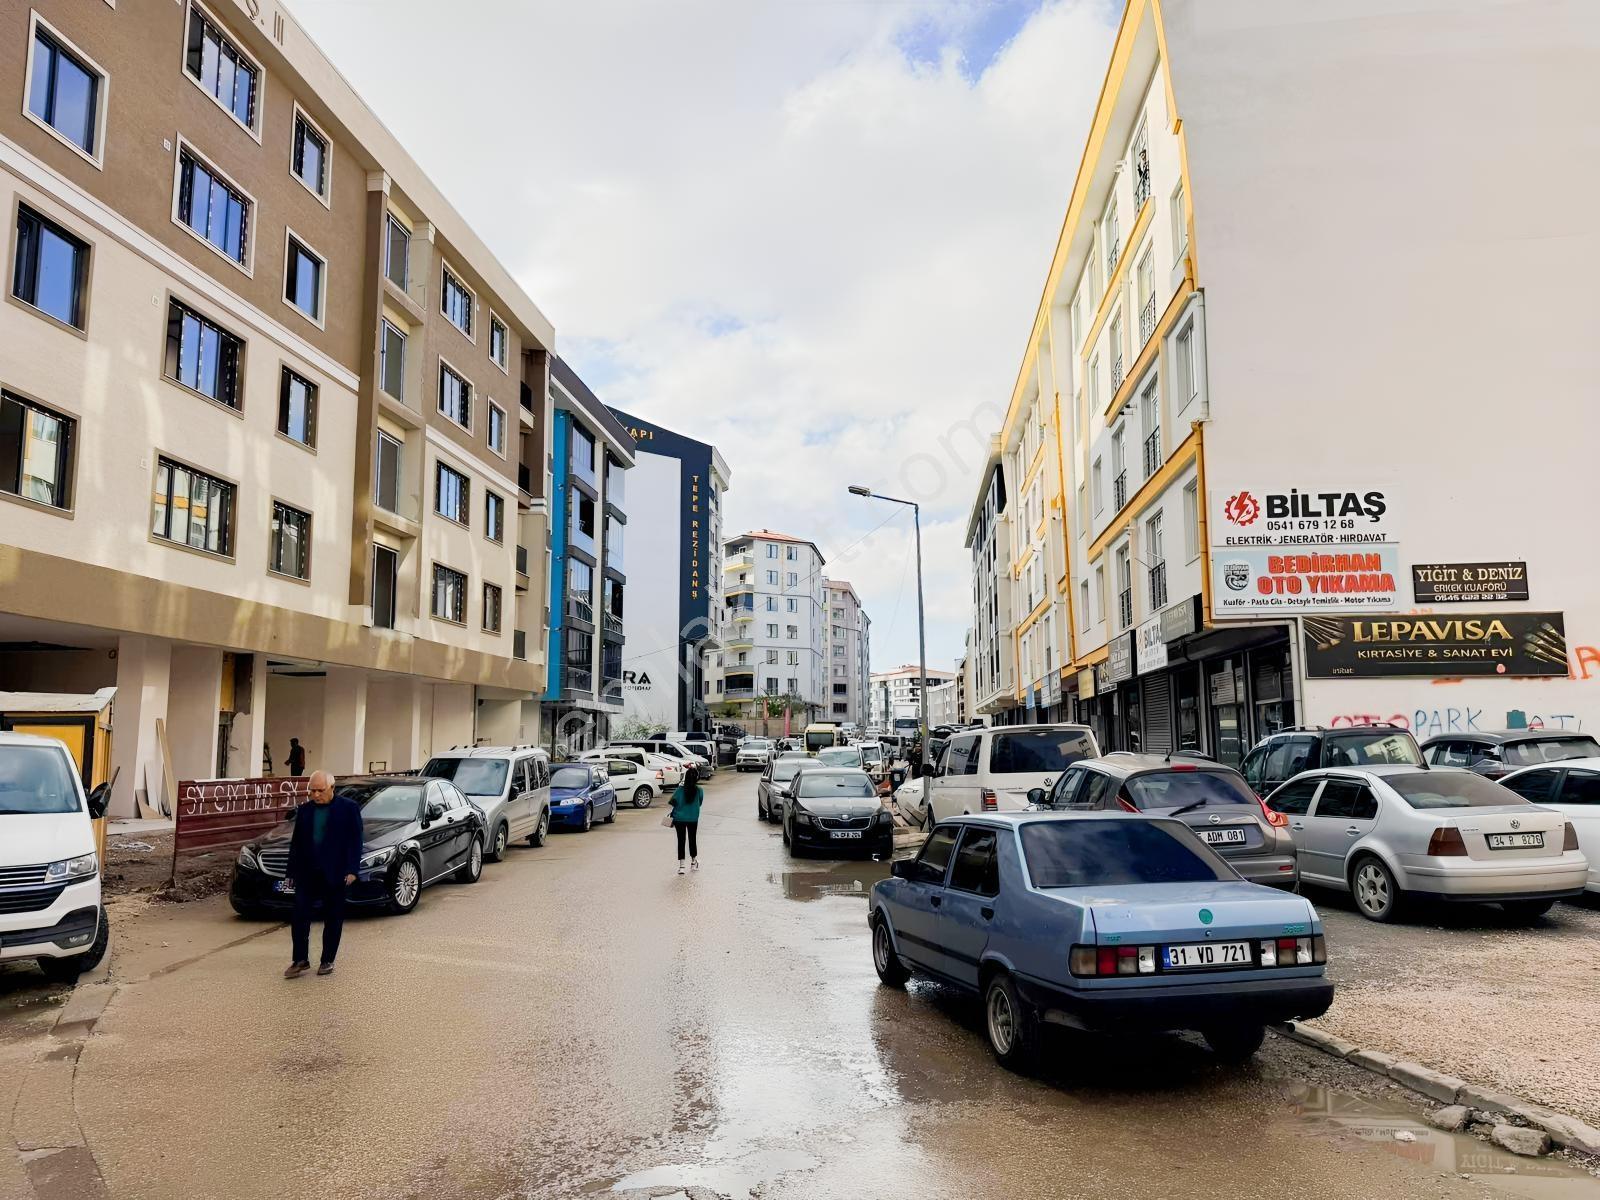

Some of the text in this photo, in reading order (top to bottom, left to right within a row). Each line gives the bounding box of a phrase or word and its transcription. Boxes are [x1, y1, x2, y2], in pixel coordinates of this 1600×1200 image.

[1266, 488, 1387, 522] BİLTAŞ
[1267, 519, 1354, 531] 0541 679 12 68
[1226, 532, 1387, 545] ELEKTRİK JENERATÖR HIRDAVAT
[1267, 551, 1382, 574] BEDİRHAN
[1416, 563, 1523, 582] YİĞİT & DENİZ
[1257, 573, 1396, 595] OTO YIKAMA
[1433, 583, 1462, 593] ERKEK
[1352, 619, 1514, 643] LEPAVISA
[1358, 648, 1422, 659] KIRTASİYE
[1427, 649, 1437, 658] &
[1443, 648, 1487, 658] SANAT
[1415, 706, 1482, 737] PARK
[1207, 831, 1223, 842] ADM
[1227, 830, 1244, 841] 081
[1493, 836, 1505, 846] 34
[1170, 944, 1247, 965] 31 VD 721
